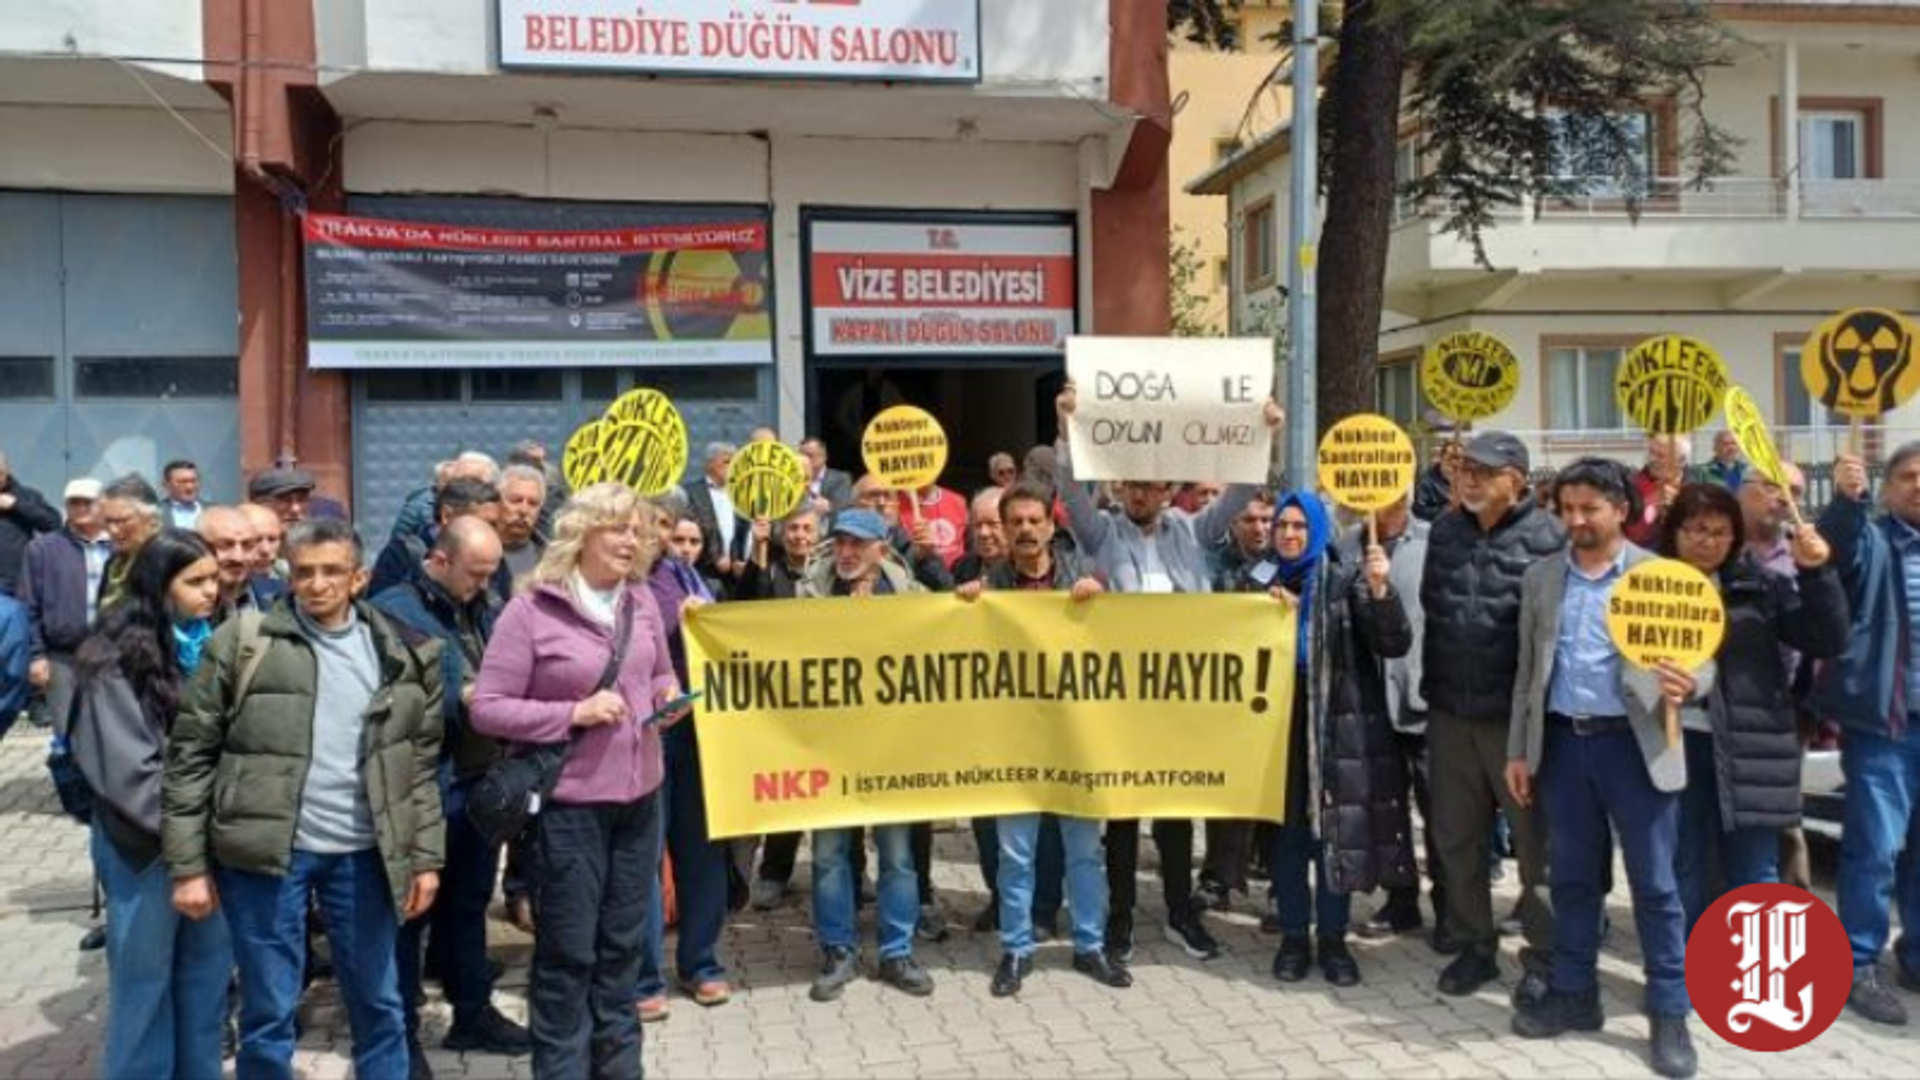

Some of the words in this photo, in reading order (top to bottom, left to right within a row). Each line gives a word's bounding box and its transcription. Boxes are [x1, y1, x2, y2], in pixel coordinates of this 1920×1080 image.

[524, 8, 690, 57] BELEDİYE
[699, 12, 821, 61] DÜĞÜN
[830, 25, 958, 66] SALONU
[837, 258, 897, 301] VİZE
[903, 263, 1045, 301] BELEDİYESİ
[1091, 419, 1163, 446] OYUN
[1334, 468, 1399, 489] HAYIR!
[1627, 572, 1706, 598] Nükleer
[1609, 596, 1722, 624] Santrallara
[1626, 621, 1704, 652] HAYIR!
[704, 651, 864, 713] NÜKLEER
[875, 650, 1127, 706] SANTRALLARA
[753, 769, 830, 802] NKP
[855, 771, 950, 794] İSTANBUL
[955, 765, 1039, 786] NÜKLEER
[1122, 769, 1226, 787] PLATFORM
